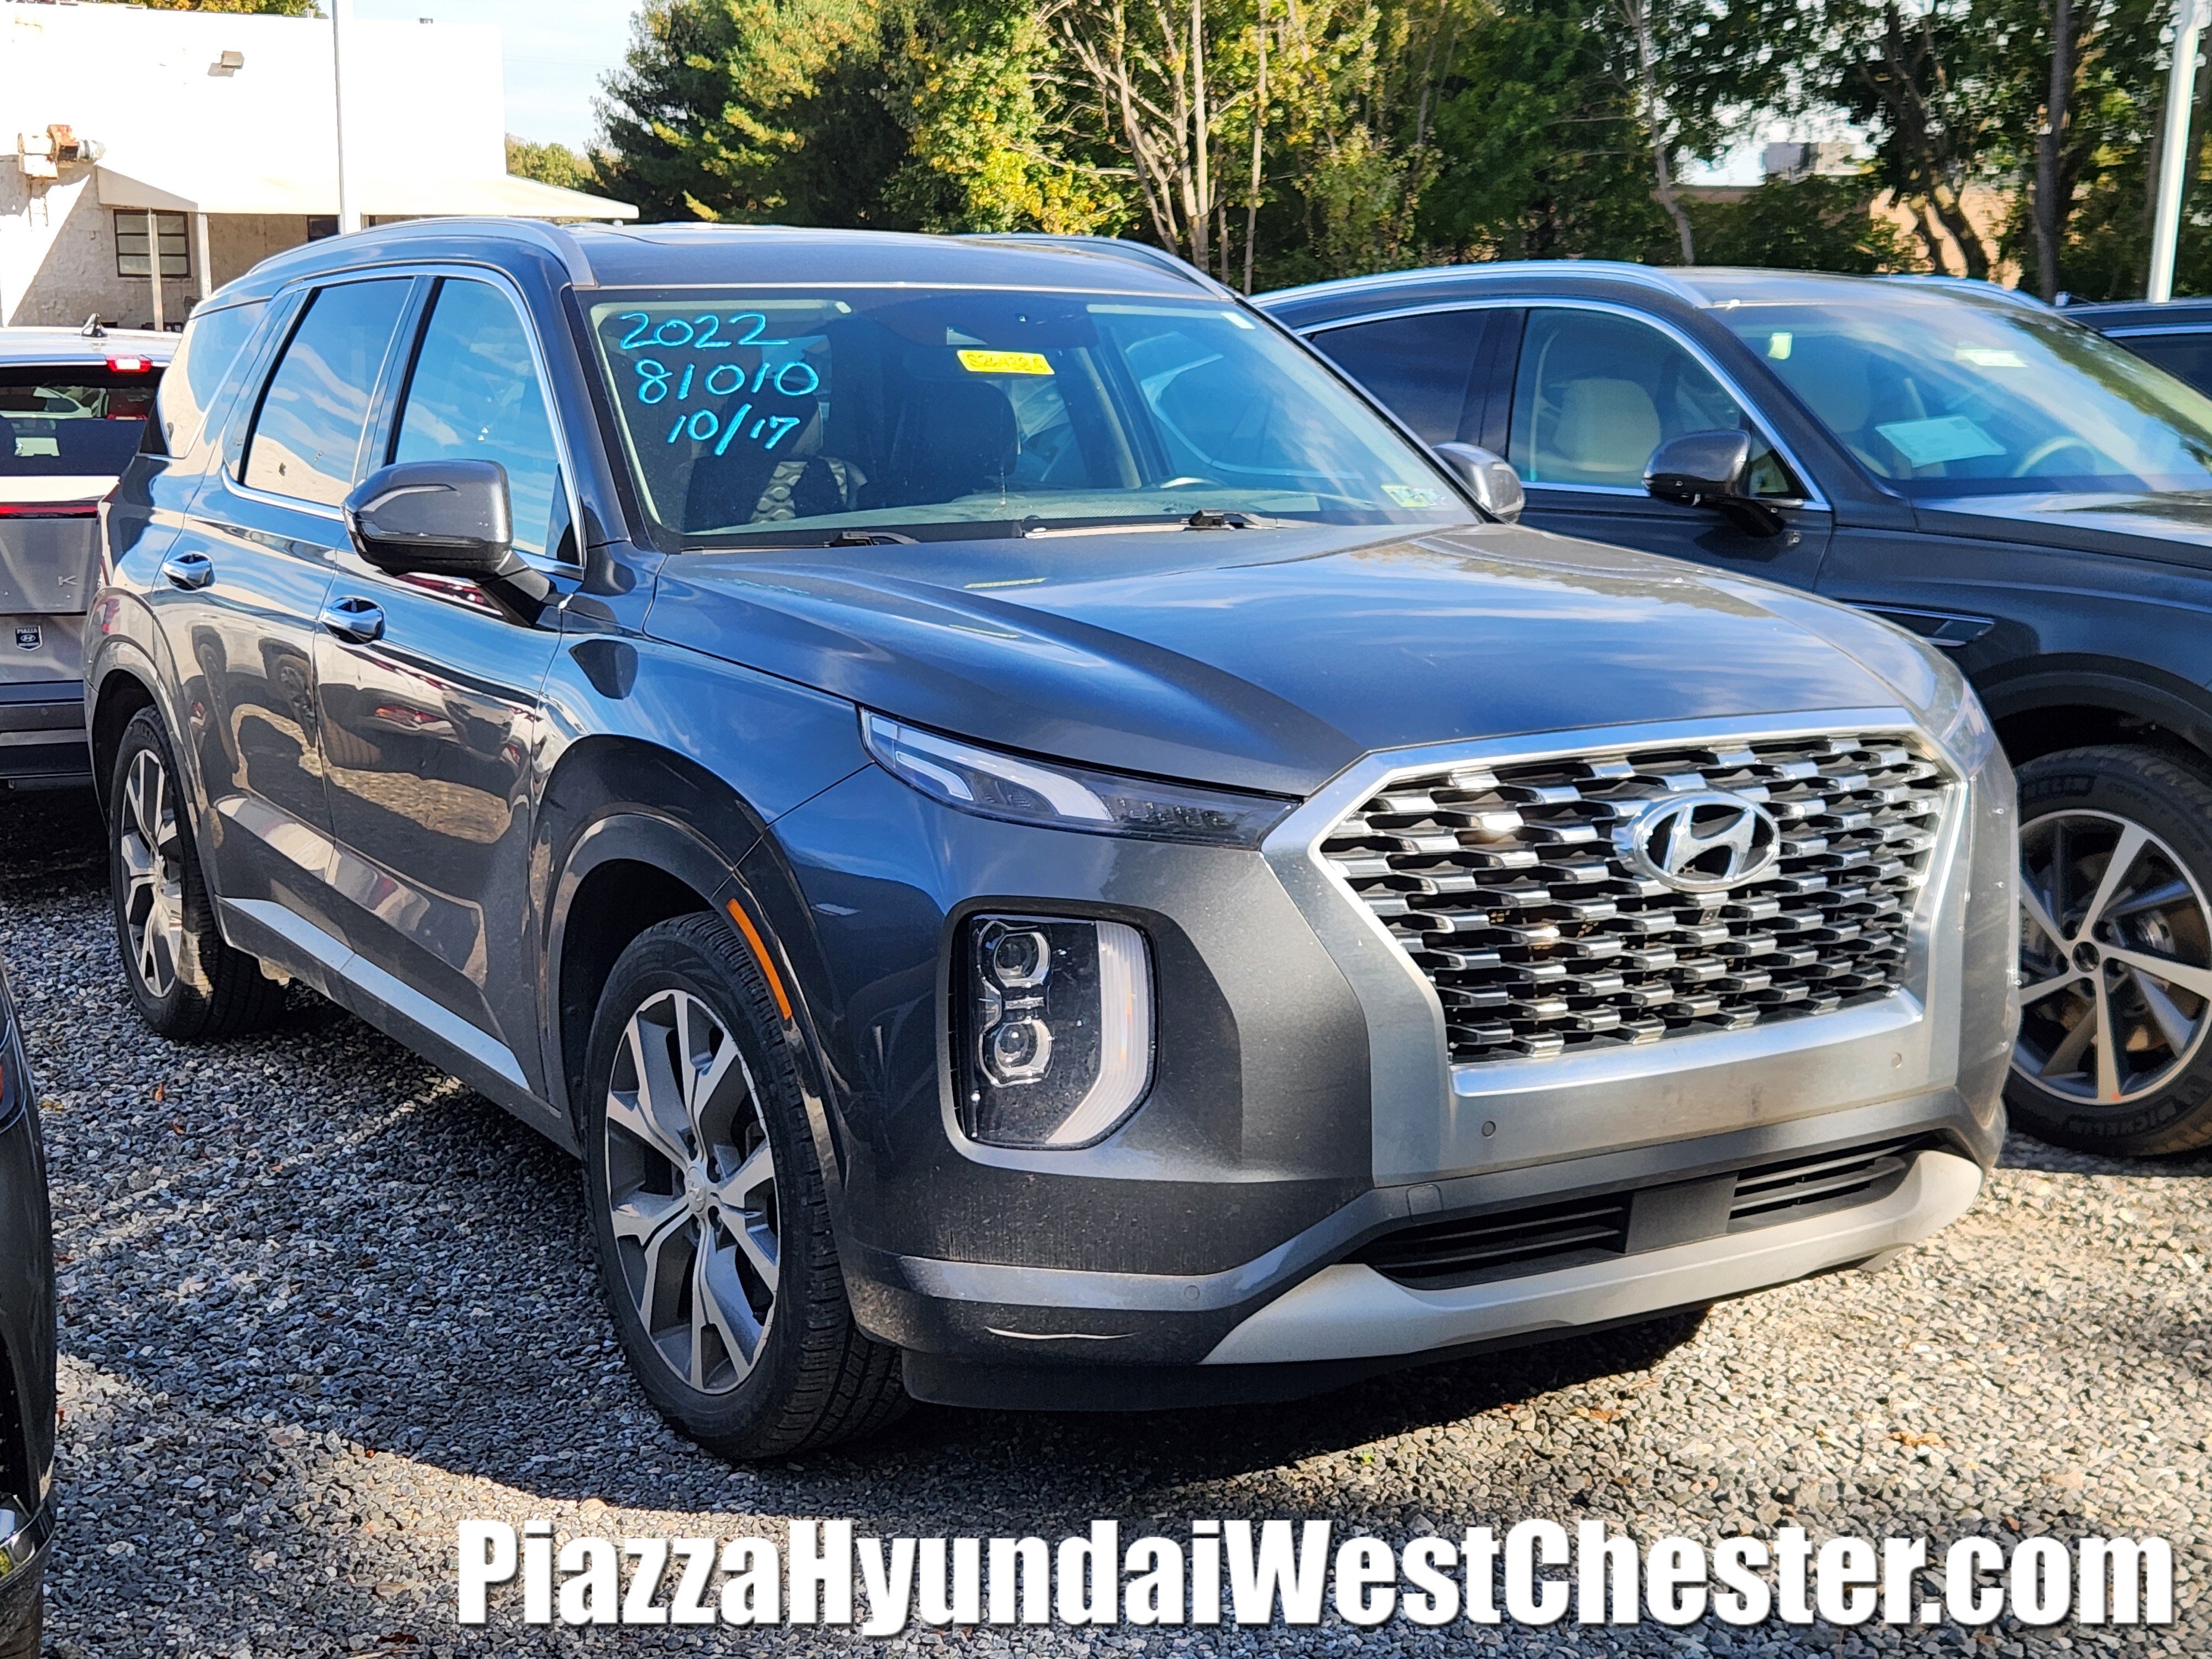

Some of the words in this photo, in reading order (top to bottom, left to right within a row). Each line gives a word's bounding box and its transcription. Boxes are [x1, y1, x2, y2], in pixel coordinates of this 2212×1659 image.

[620, 311, 790, 349] 2022
[636, 358, 819, 404] 81010
[667, 403, 801, 456] 10/17
[58, 576, 77, 586] K
